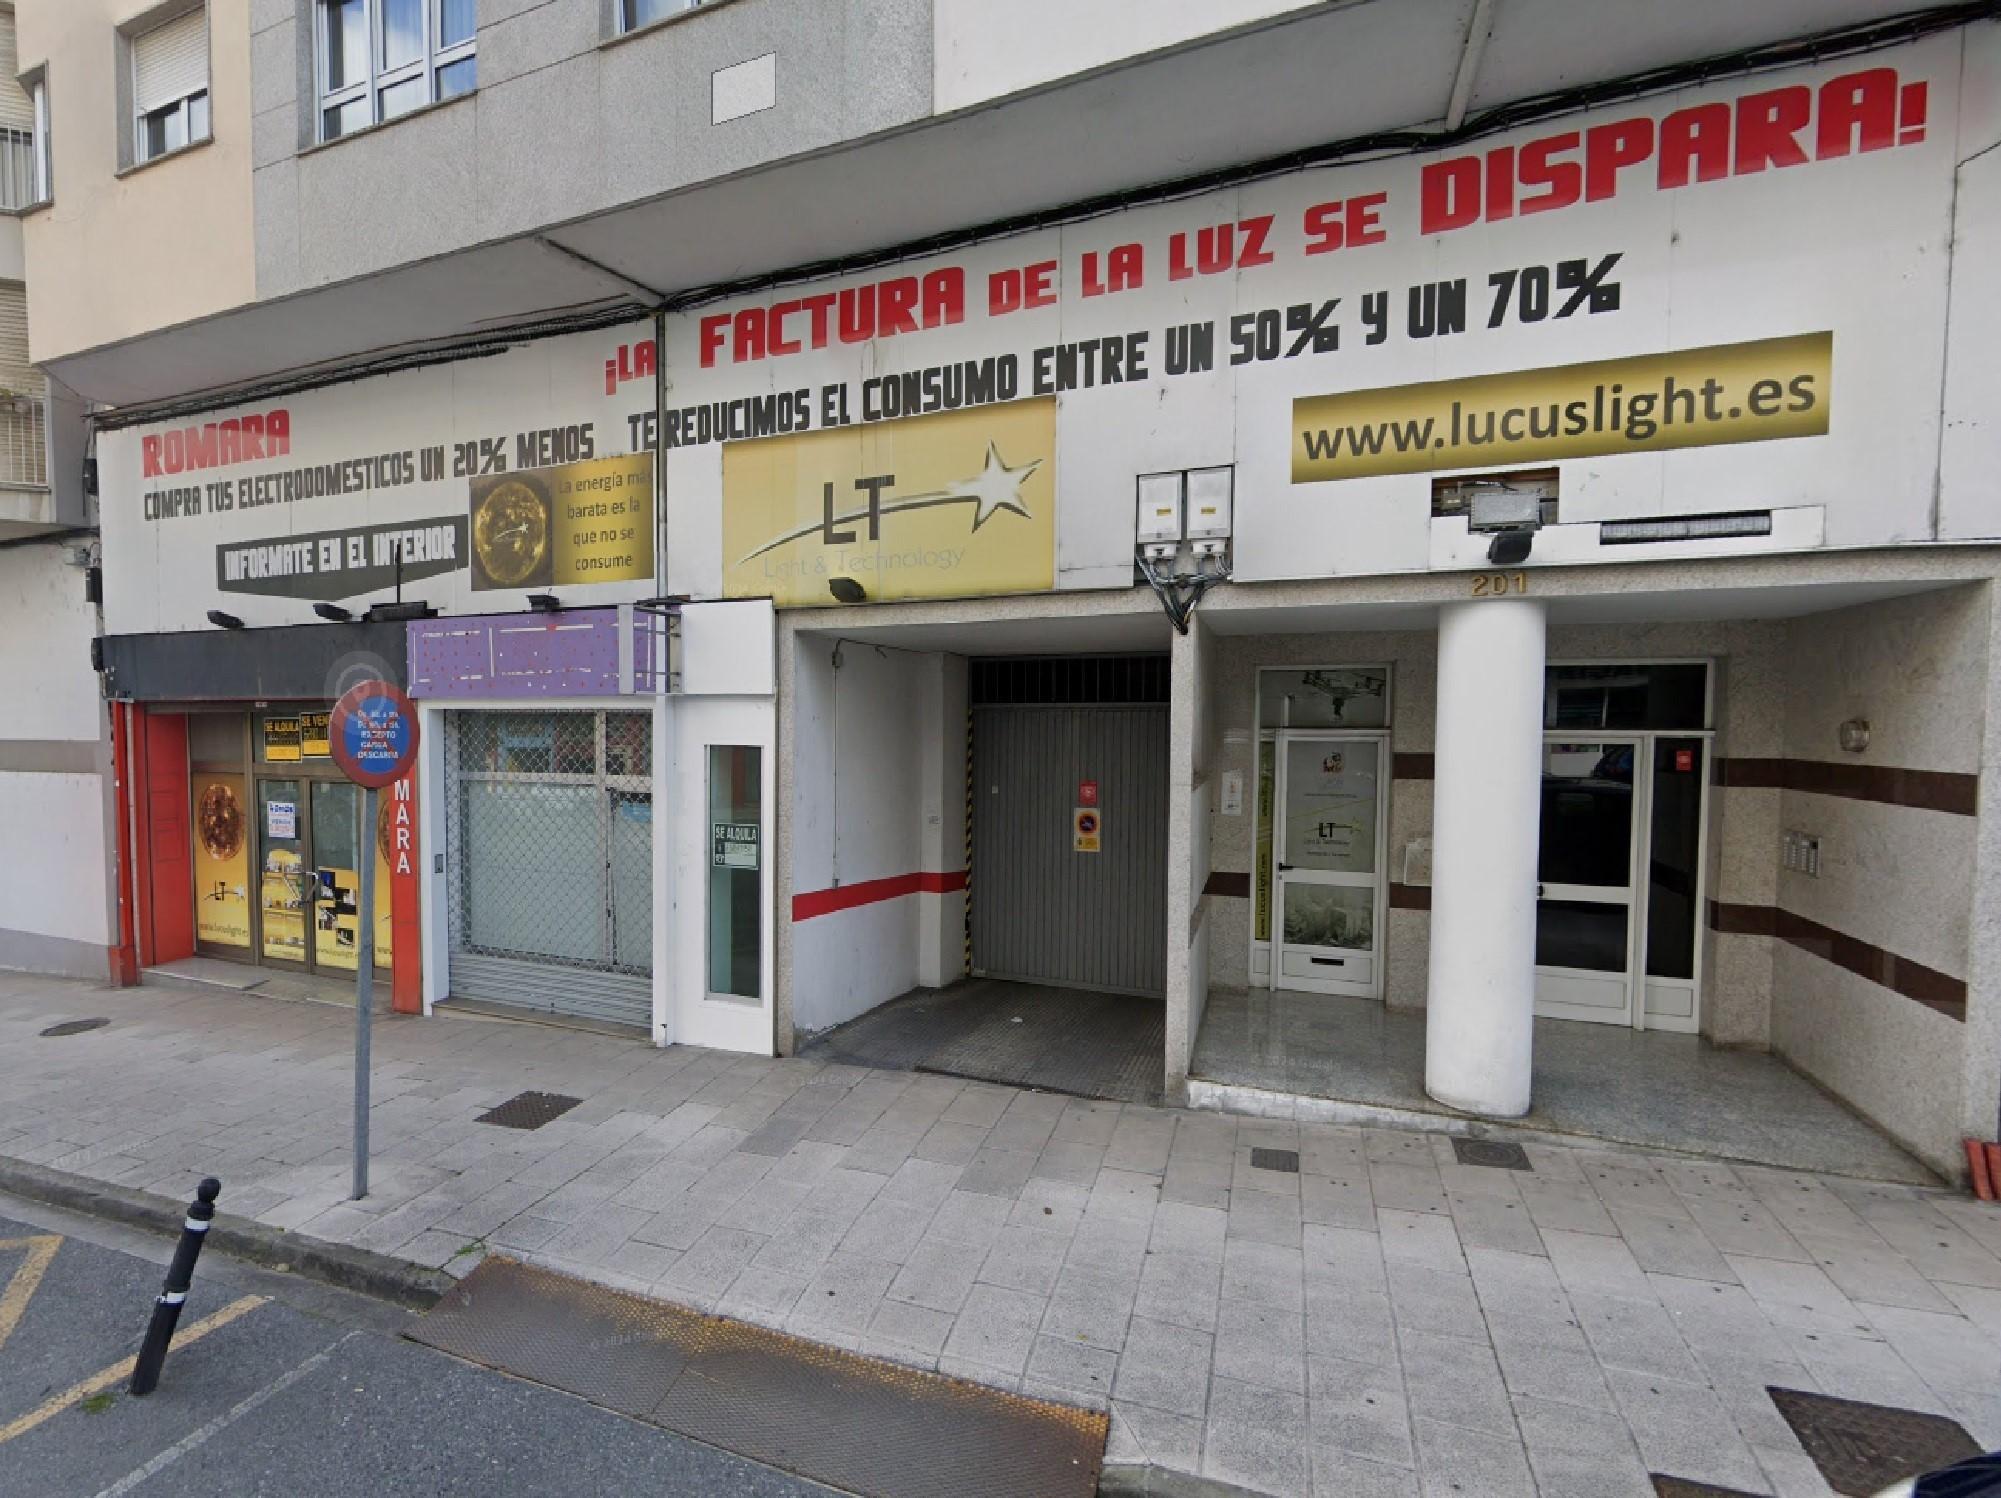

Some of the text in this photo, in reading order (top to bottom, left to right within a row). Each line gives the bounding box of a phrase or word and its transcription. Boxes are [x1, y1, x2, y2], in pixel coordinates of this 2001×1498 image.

[699, 267, 964, 368] FACTURA
[988, 260, 1057, 316] DE
[1081, 243, 1144, 297] LA
[1168, 214, 1274, 281] LUZ
[1304, 192, 1387, 256] SE
[1420, 67, 1929, 235] DISPARA!
[628, 252, 1623, 452] TE REDUCIMOS EL CONSUMO ENTRE UN 50% Y UN 70%
[143, 410, 290, 478] ROMARA
[1302, 371, 1816, 461] www.lucuslight.es
[144, 422, 594, 521] COMPRA TUS ELECTRODOMESTICOS UN 20% MENOS
[575, 471, 623, 492] energía
[567, 496, 640, 520] barata es la
[573, 527, 635, 548] que no se
[823, 475, 895, 545] LT
[225, 525, 456, 581] INFORMATE EN EL INTERIOR
[575, 554, 633, 571] consume
[1471, 571, 1527, 597] 201
